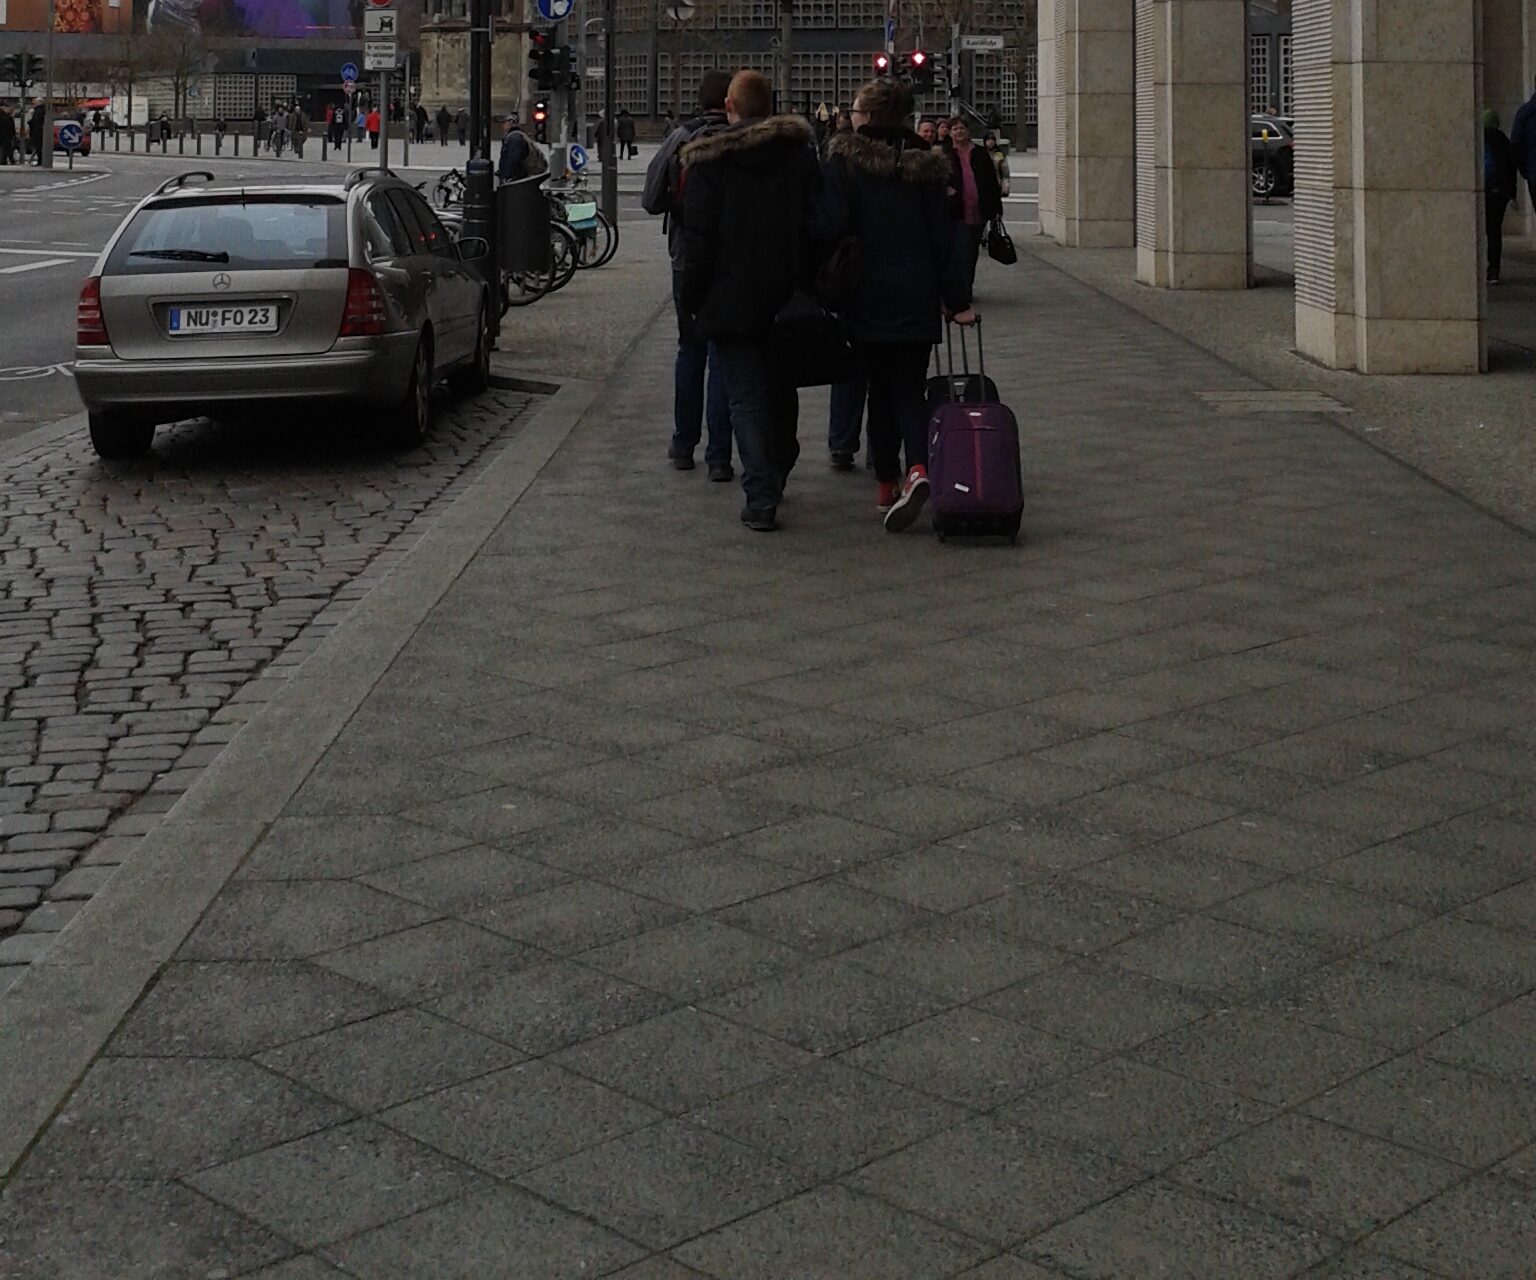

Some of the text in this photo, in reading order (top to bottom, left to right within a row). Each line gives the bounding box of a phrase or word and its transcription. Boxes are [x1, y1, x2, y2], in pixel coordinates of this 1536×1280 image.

[186, 307, 270, 327] NU FO 23
